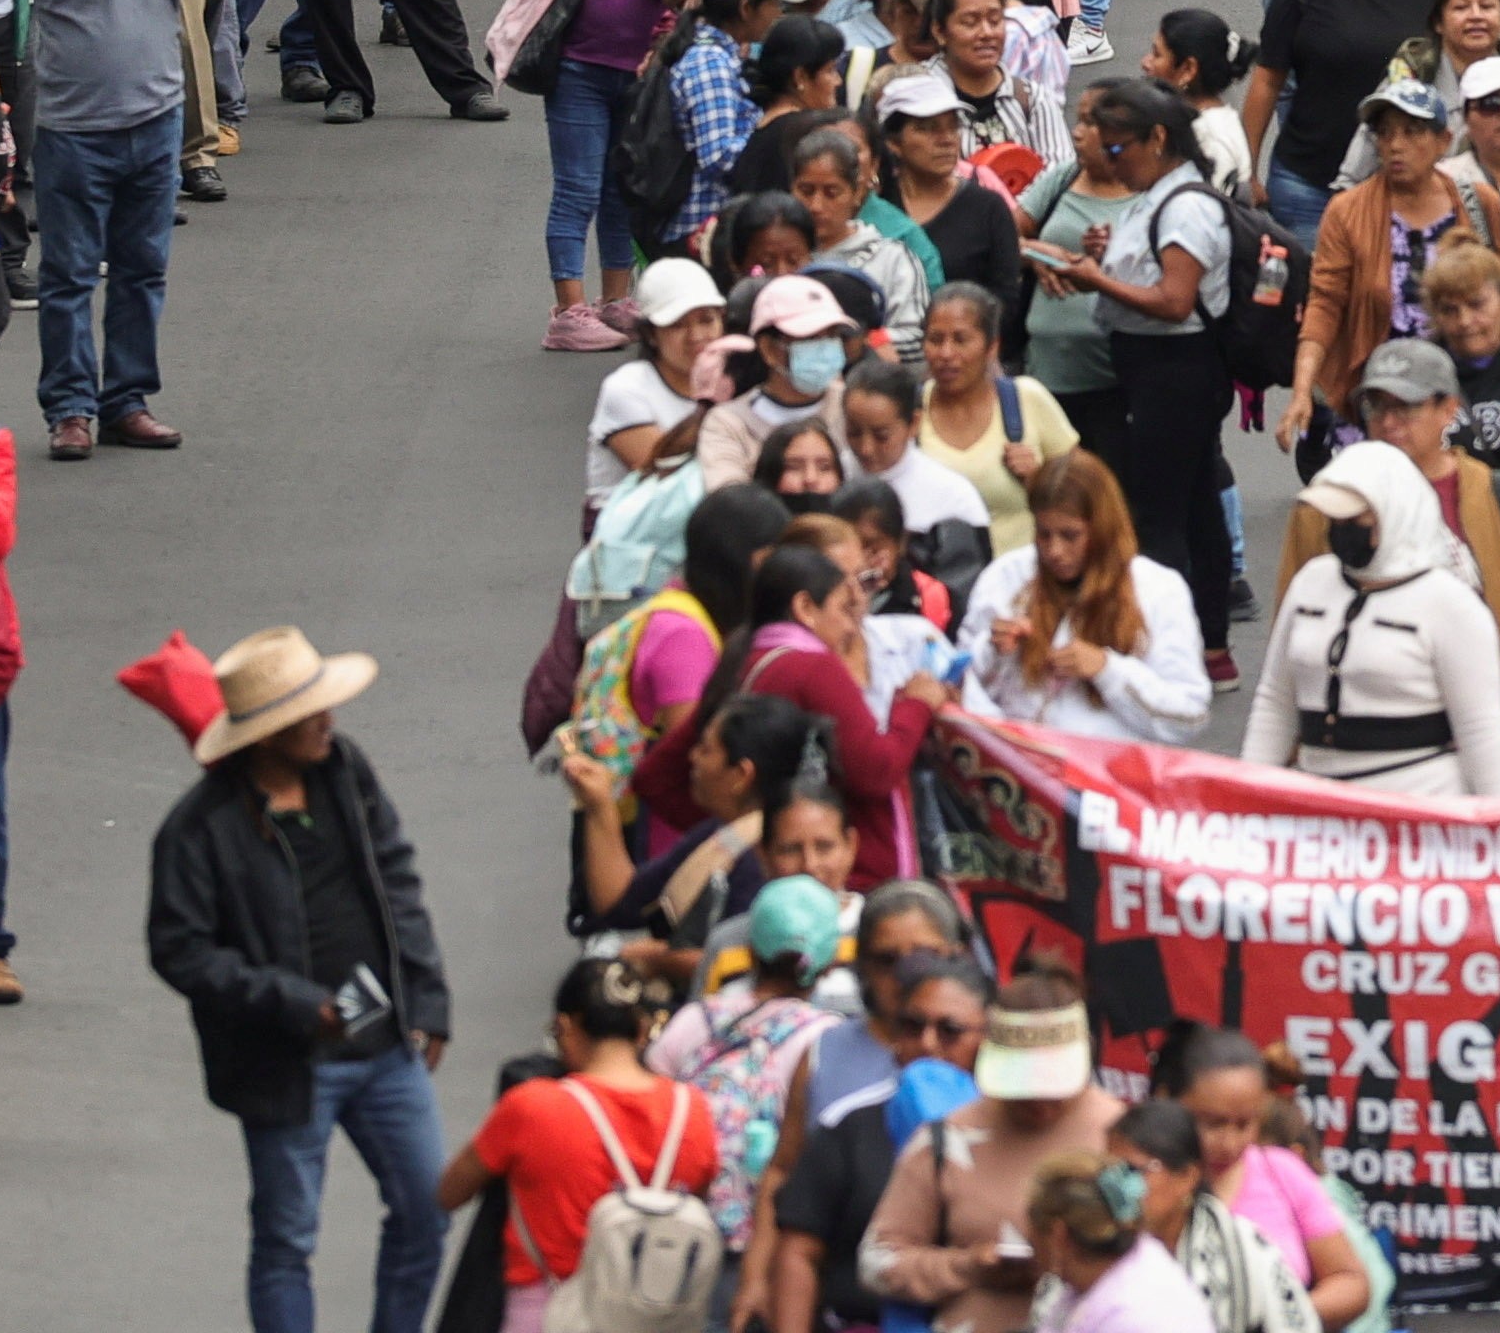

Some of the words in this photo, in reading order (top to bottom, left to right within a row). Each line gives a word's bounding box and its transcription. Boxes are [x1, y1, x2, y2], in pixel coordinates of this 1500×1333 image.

[1077, 789, 1132, 855] EL
[1139, 807, 1389, 880] MAGISTERIO
[1109, 864, 1471, 947] FLORENCIO
[1302, 949, 1450, 995] CRUZ
[1357, 1096, 1419, 1134] DE
[1428, 1099, 1486, 1136] LA
[1325, 1146, 1416, 1188] POR
